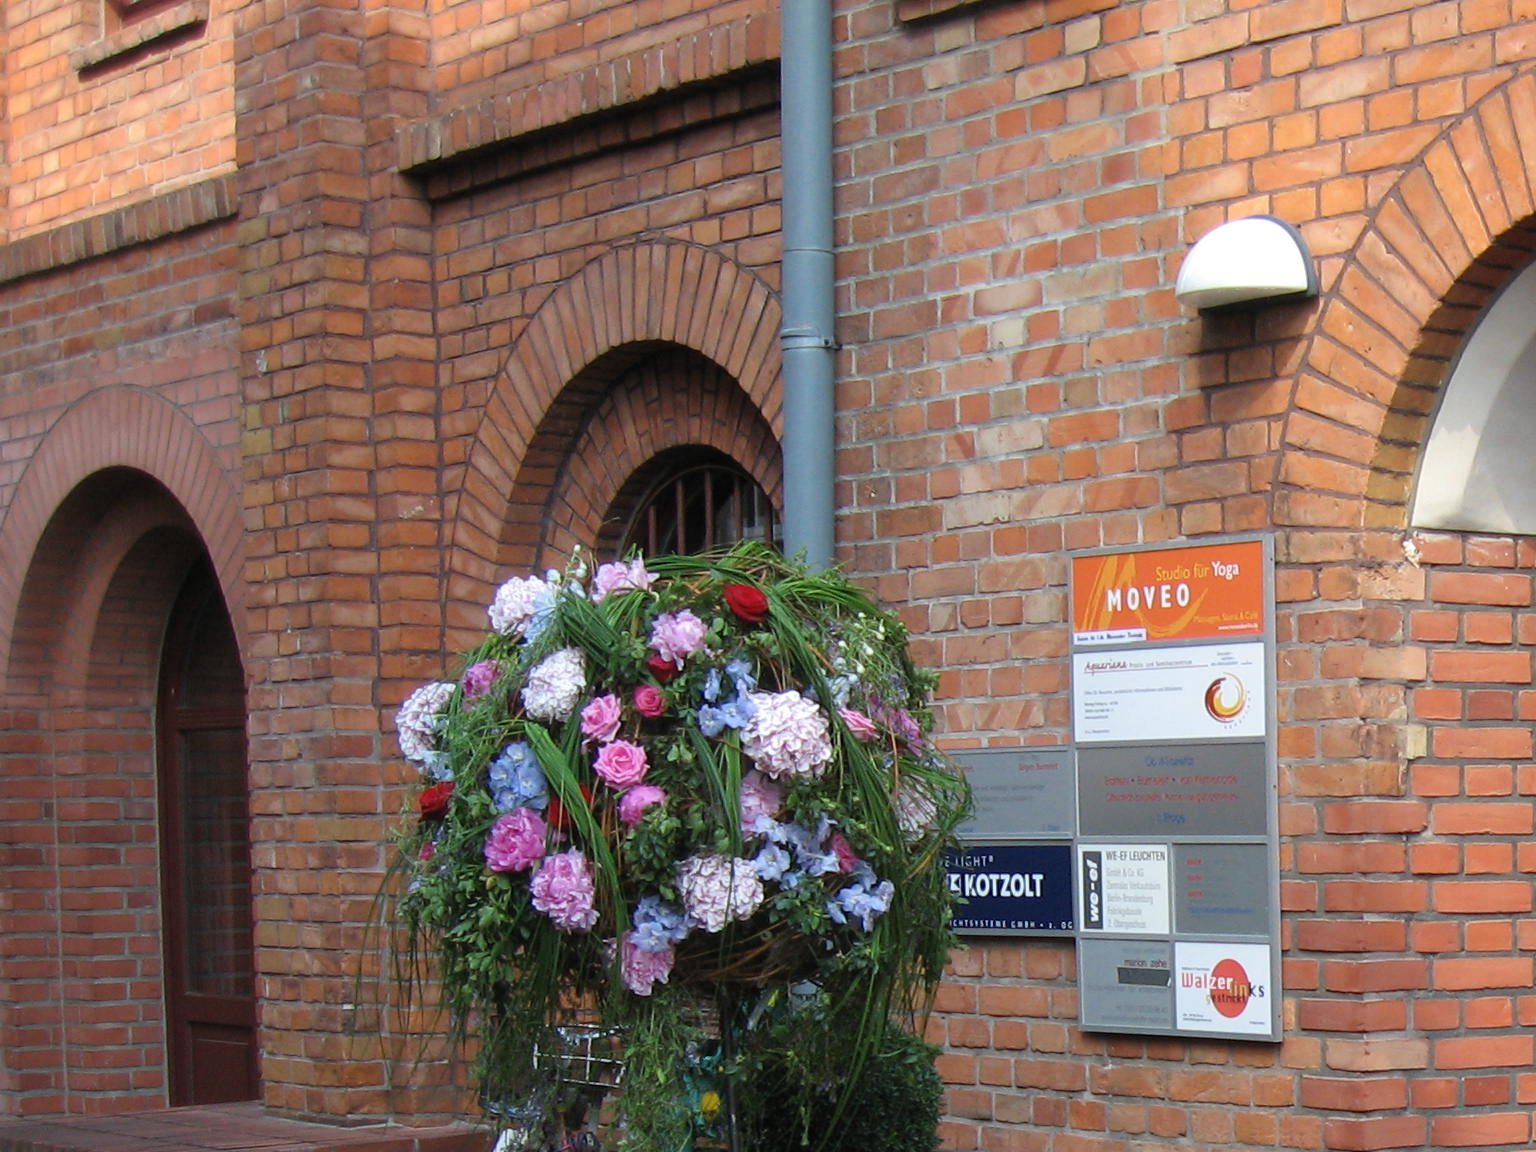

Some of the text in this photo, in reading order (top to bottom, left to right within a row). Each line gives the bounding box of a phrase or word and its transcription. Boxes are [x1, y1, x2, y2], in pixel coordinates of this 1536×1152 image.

[1156, 560, 1240, 582] Studio für Yoga
[1107, 583, 1190, 612] MOVEO
[1106, 850, 1166, 861] WE-EF LEUCHTEN
[965, 873, 1044, 897] KOTZOLT
[1182, 973, 1233, 990] Walzer
